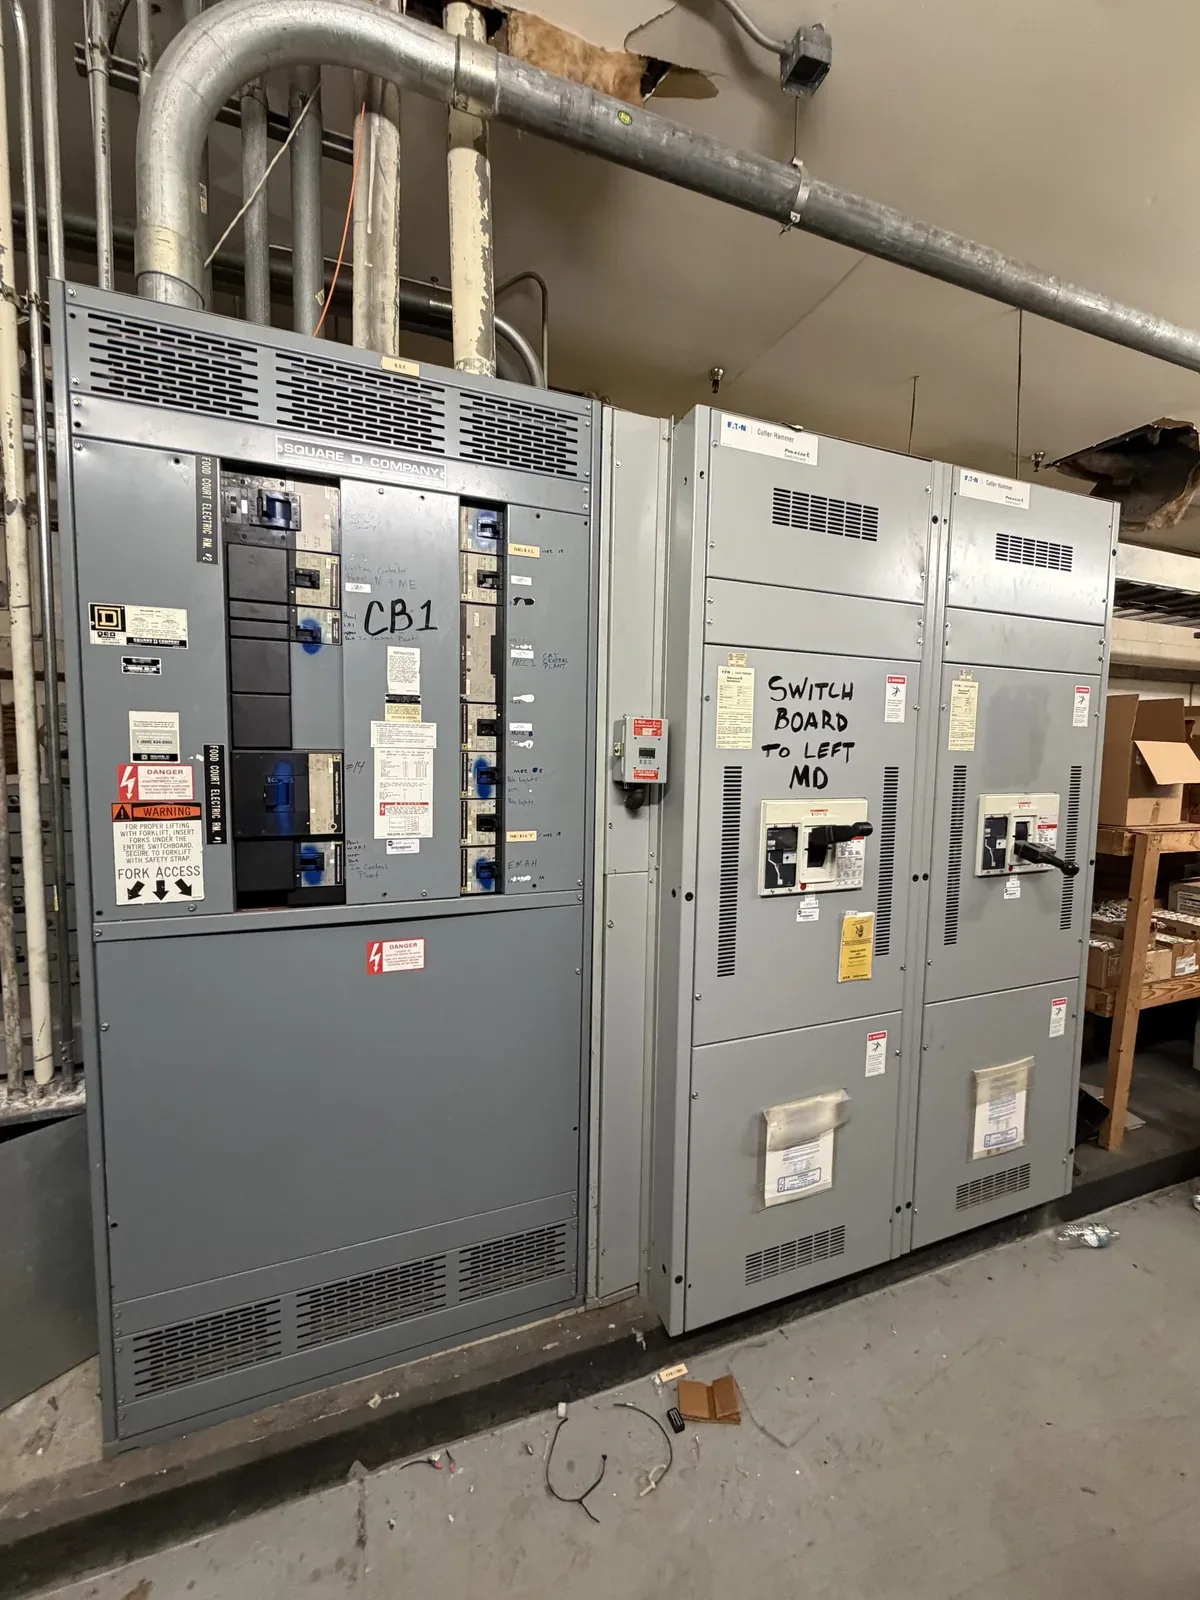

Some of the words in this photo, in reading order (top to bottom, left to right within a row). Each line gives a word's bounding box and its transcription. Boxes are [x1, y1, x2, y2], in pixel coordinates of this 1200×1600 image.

[757, 427, 795, 443] Cutler-Hammer
[201, 456, 212, 475] FOOD
[283, 443, 344, 462] SQUARE
[351, 454, 363, 465] D
[369, 457, 440, 477] COMPANY
[202, 479, 212, 500] COURT
[202, 503, 213, 535] ELECTRIC
[203, 537, 213, 549] RM.
[364, 598, 438, 636] CB1
[768, 675, 854, 702] SWITCH
[774, 707, 848, 733] BOARD
[209, 745, 219, 762] FOOD
[804, 742, 856, 764] LEFT
[210, 765, 220, 785] COURT
[789, 764, 829, 790] MD
[143, 807, 191, 817] WARNING
[210, 788, 221, 819] ELECTRIC
[173, 828, 195, 836] INSERT
[122, 843, 145, 851] ENTIRE
[118, 868, 150, 880] FORK
[156, 865, 201, 878] ACCESS
[389, 942, 418, 950] DANGER
